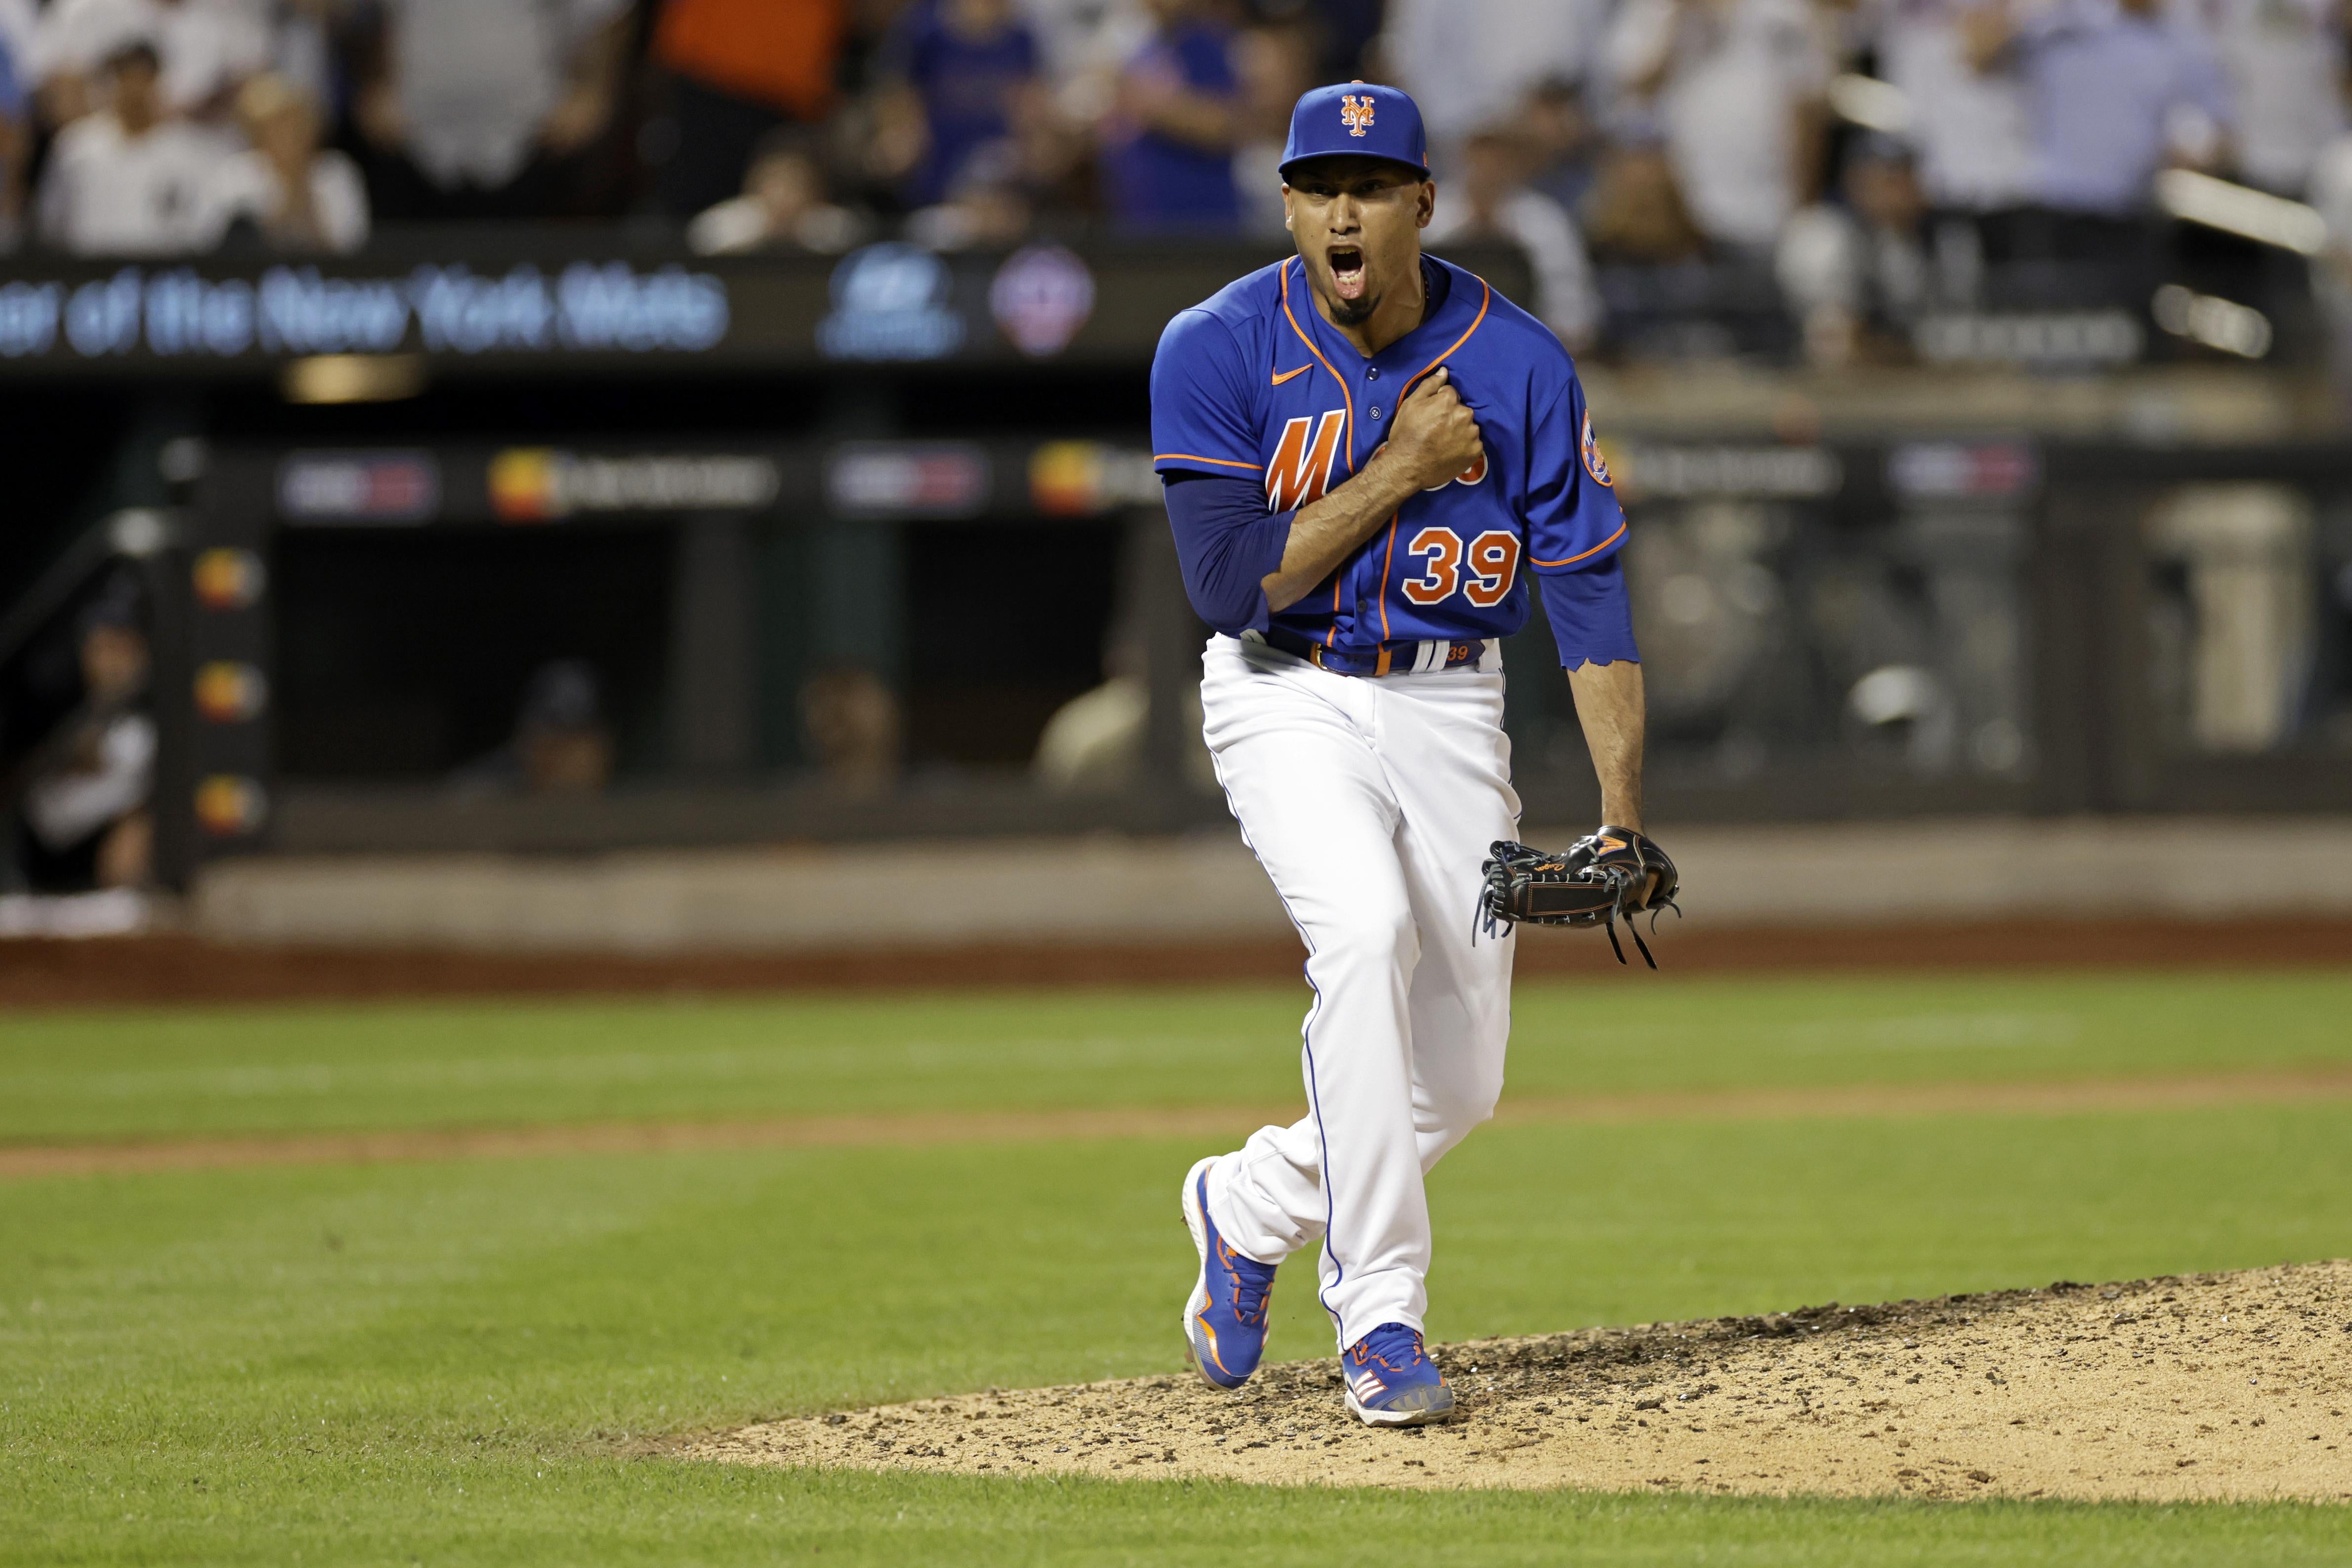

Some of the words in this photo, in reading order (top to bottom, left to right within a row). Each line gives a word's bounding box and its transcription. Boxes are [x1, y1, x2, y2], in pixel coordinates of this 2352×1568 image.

[1341, 95, 1375, 137] NY
[65, 265, 142, 357] of
[144, 265, 255, 357] the
[258, 263, 409, 354] New
[411, 262, 553, 354] York
[557, 260, 730, 352] Mets
[1402, 527, 1521, 607] 39
[1447, 645, 1469, 661] 39
